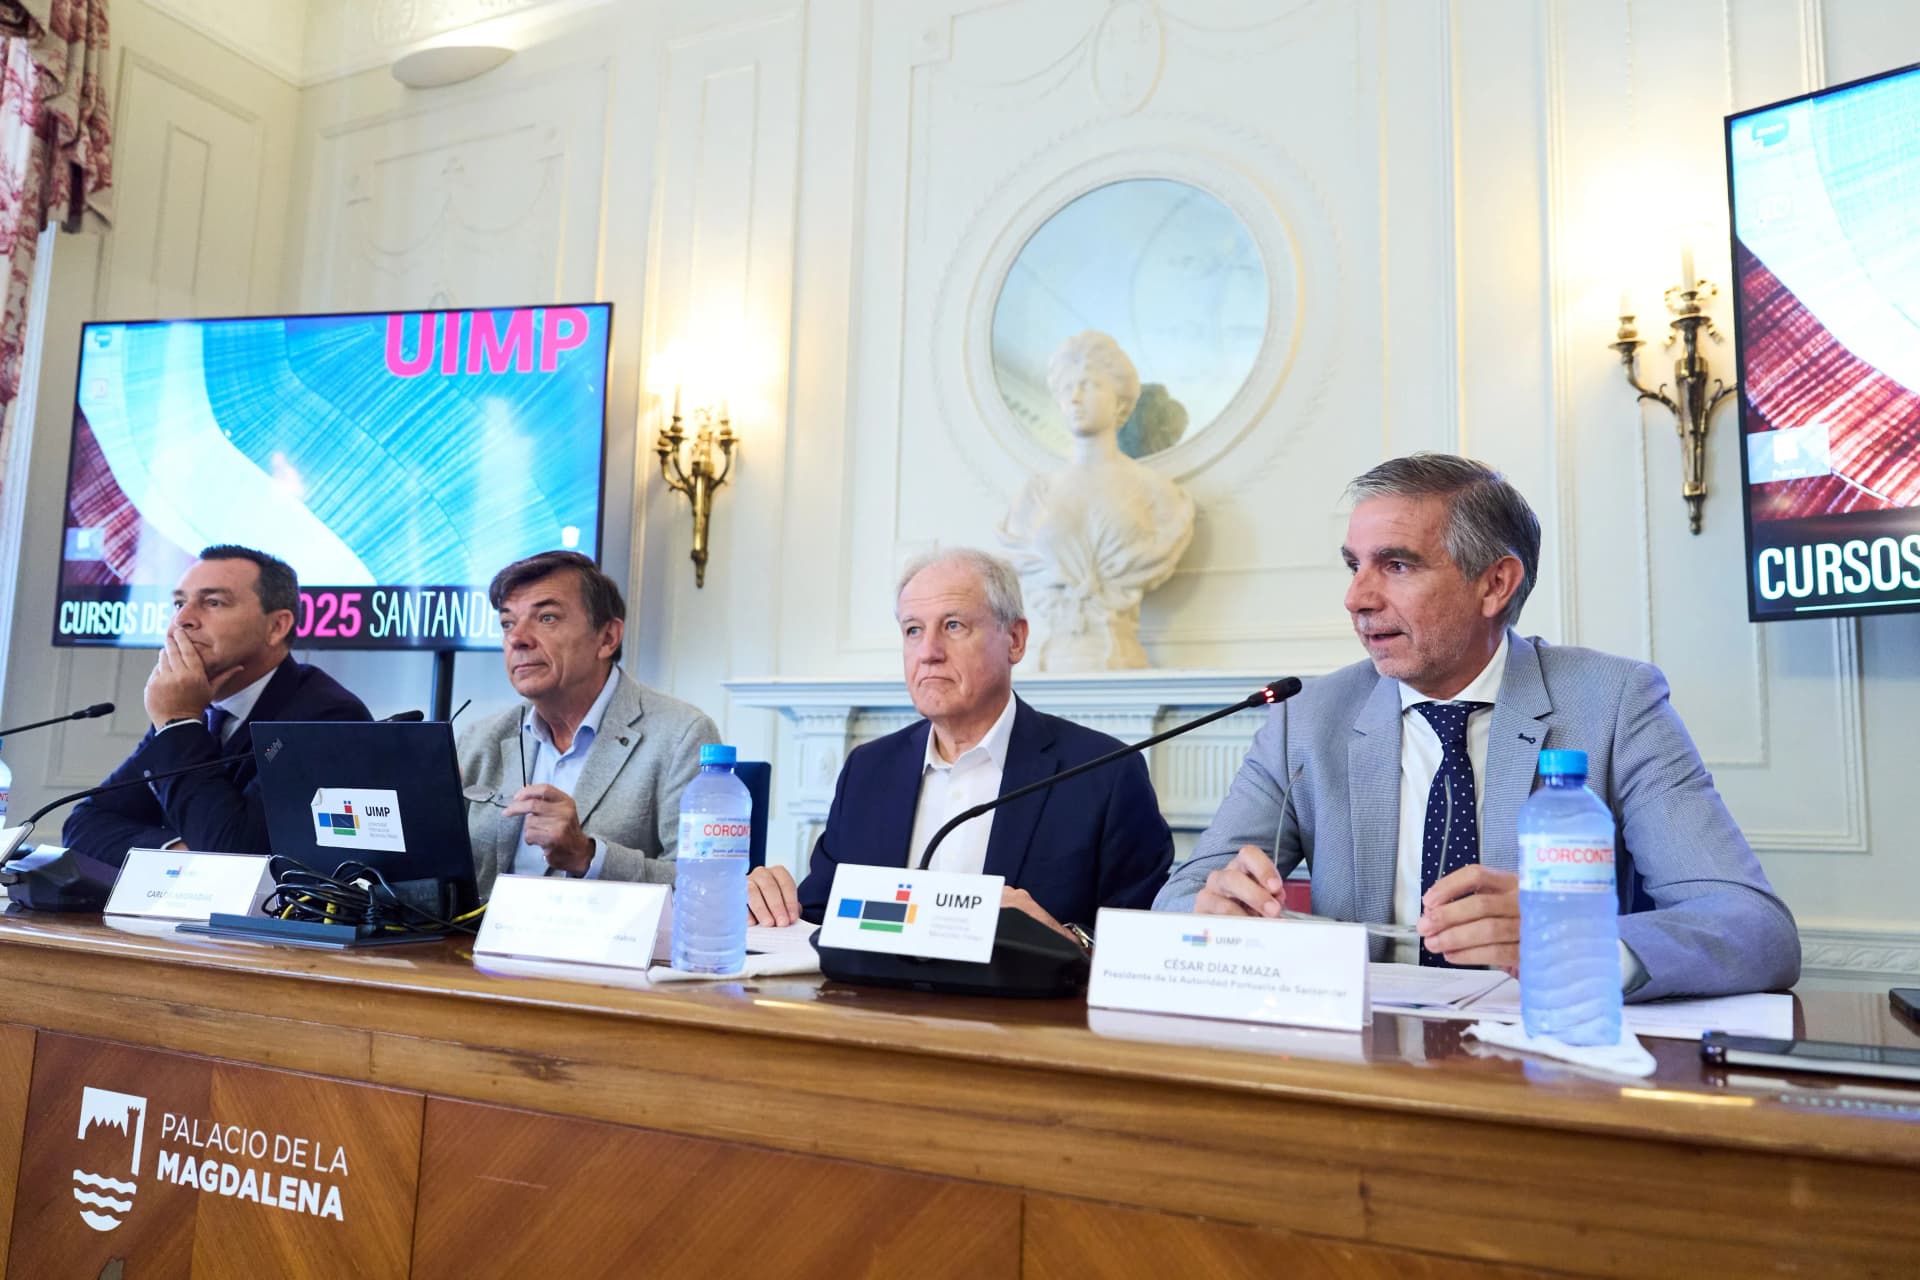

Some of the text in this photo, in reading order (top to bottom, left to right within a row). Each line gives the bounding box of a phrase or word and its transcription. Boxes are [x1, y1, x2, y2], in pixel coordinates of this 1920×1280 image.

[385, 308, 590, 378] UIMP
[1758, 535, 1920, 600] CURSOS
[59, 601, 138, 635] CURSOS
[296, 592, 362, 637] 025
[370, 590, 501, 638] SANTANDE
[365, 806, 391, 817] UIMP
[935, 893, 983, 909] UIMP
[1216, 936, 1242, 946] UIMP
[1103, 969, 1152, 981] Presidente
[1163, 957, 1281, 978] CÉSAR DÍAZ MAZA
[161, 1112, 349, 1177] PALACIO DE LA
[157, 1150, 344, 1222] MAGDALENA
